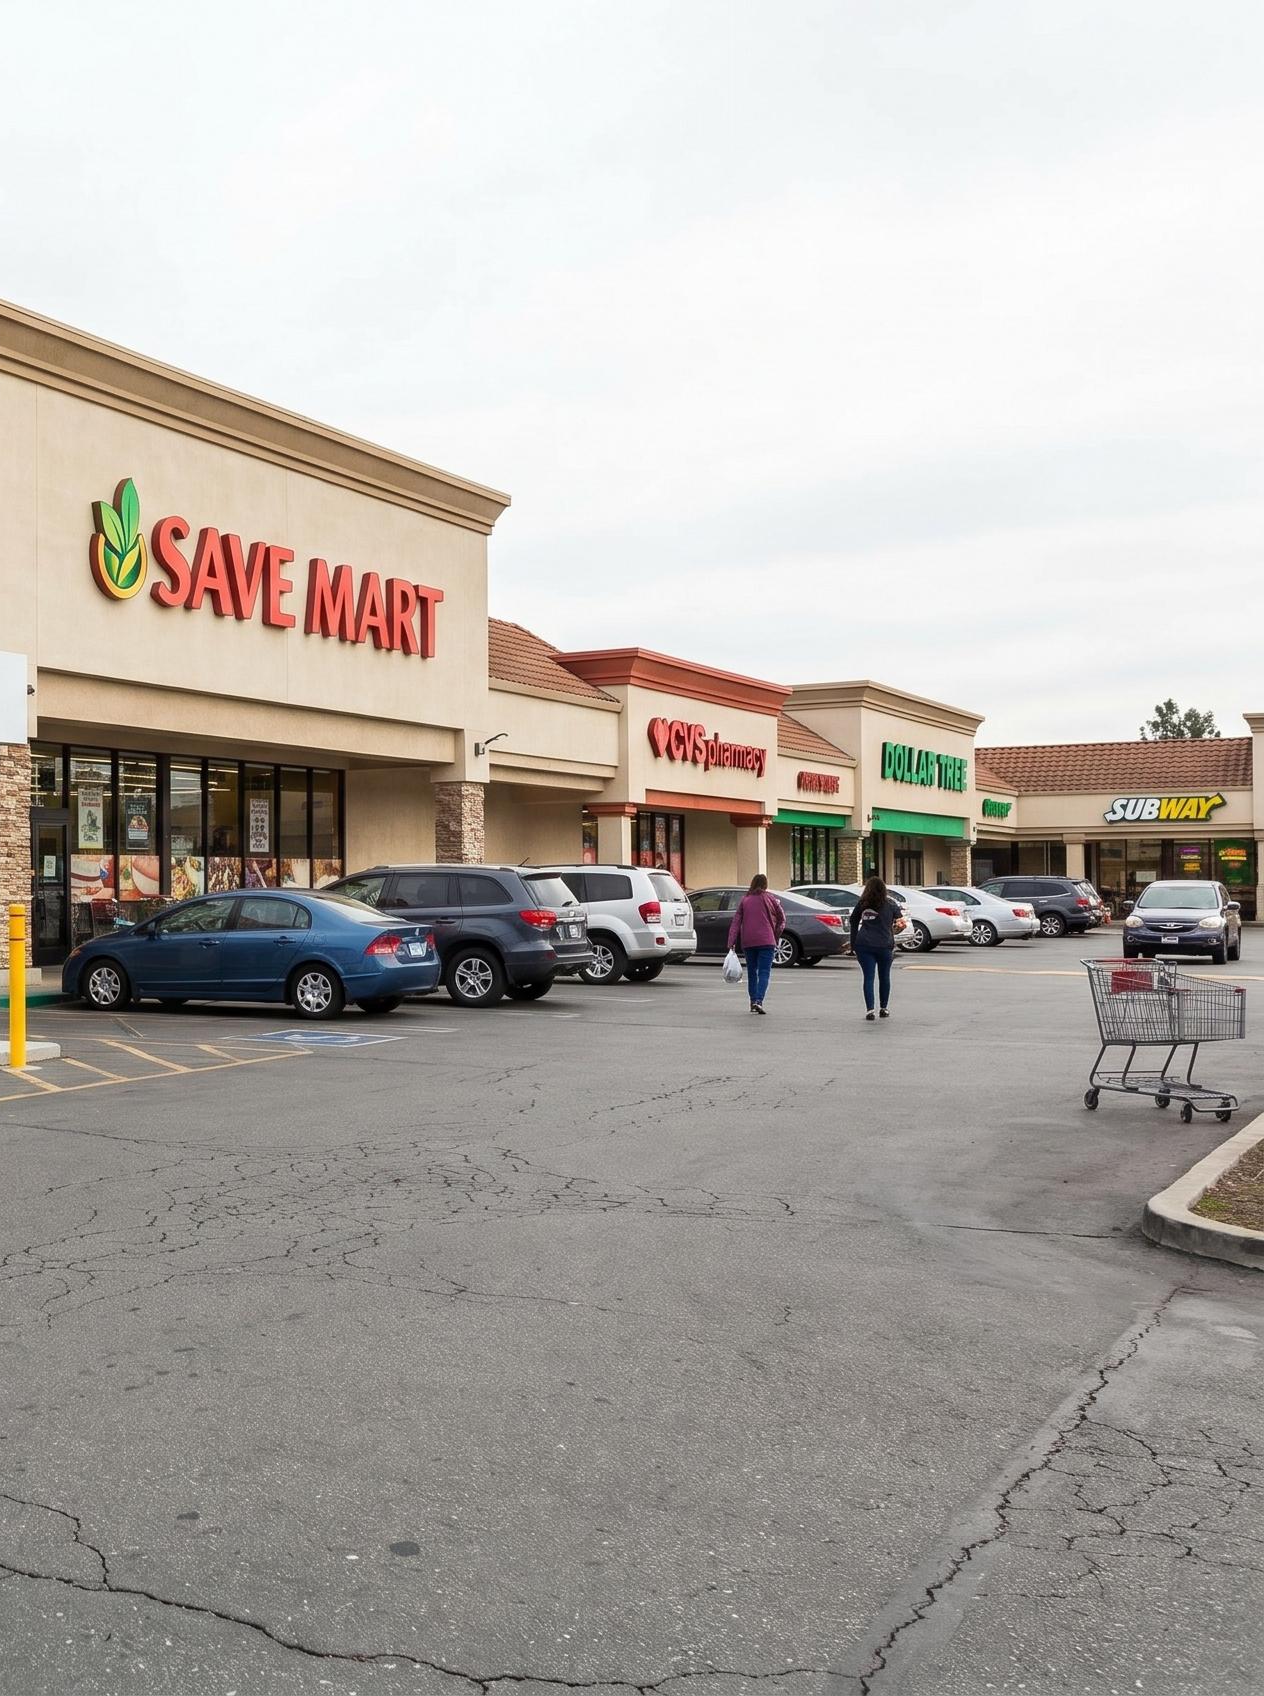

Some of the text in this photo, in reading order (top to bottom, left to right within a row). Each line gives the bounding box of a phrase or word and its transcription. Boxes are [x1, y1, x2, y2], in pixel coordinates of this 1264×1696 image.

[151, 515, 445, 659] SAVE MART
[668, 720, 767, 778] CVS pharmacy
[881, 742, 936, 787] DOLLAR
[937, 754, 967, 792] TREE
[1105, 794, 1226, 822] SUBWAY
